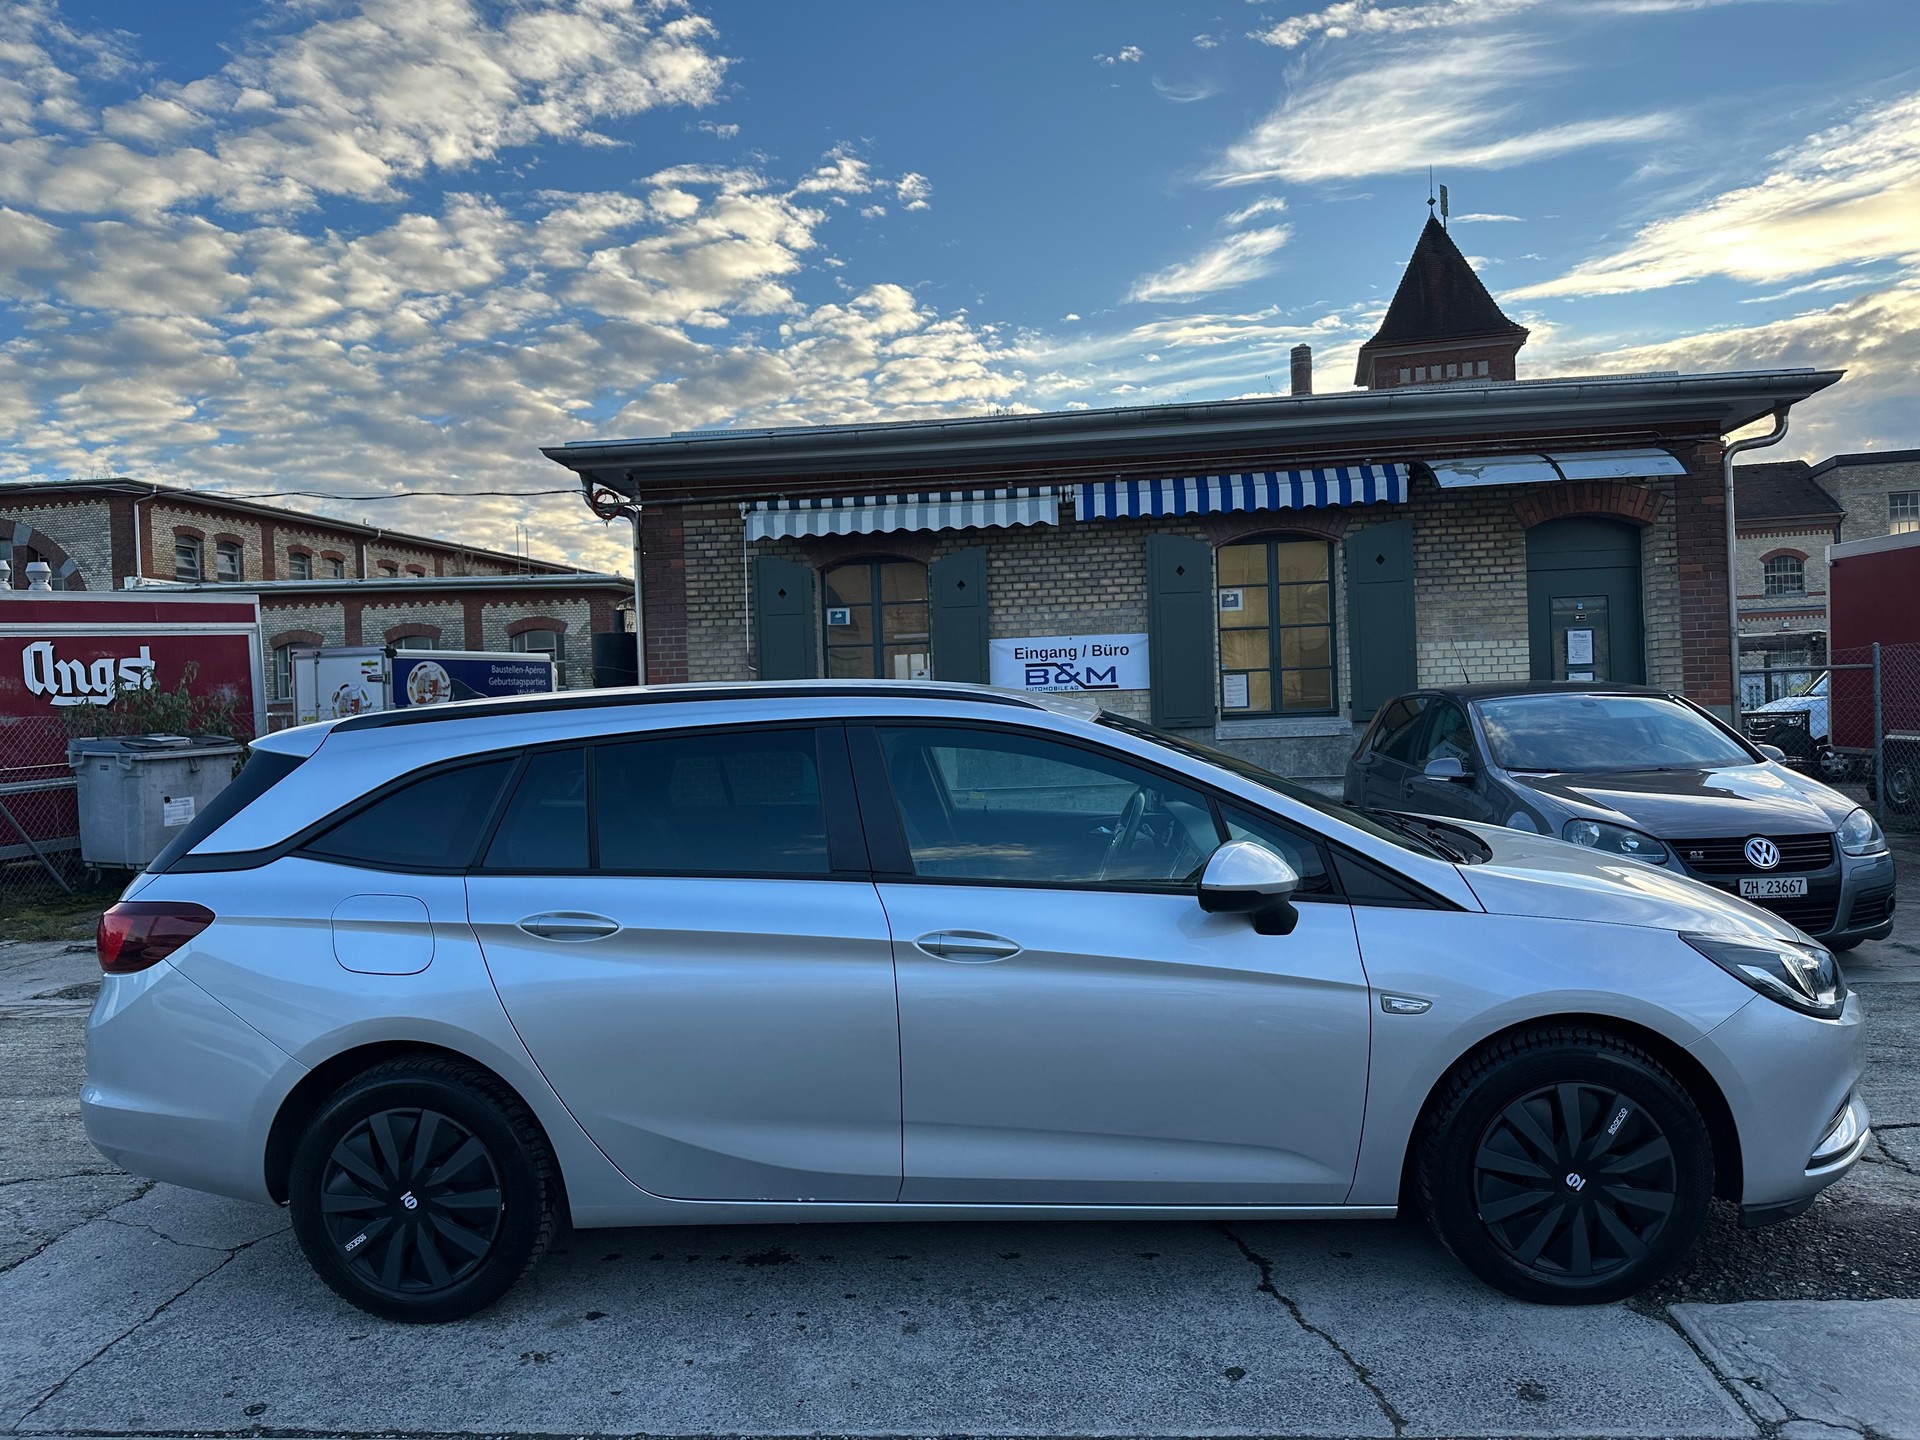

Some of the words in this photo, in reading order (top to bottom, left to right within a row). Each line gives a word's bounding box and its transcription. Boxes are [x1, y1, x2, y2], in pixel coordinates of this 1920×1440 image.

[1014, 647, 1077, 661] Eingang
[1082, 644, 1087, 657] /
[1091, 644, 1130, 657] Büro
[22, 641, 156, 706] Angst
[491, 664, 546, 675] Baustellen-Apéros
[488, 676, 547, 688] Geburtstagsparties
[1607, 1107, 1628, 1135] sparco
